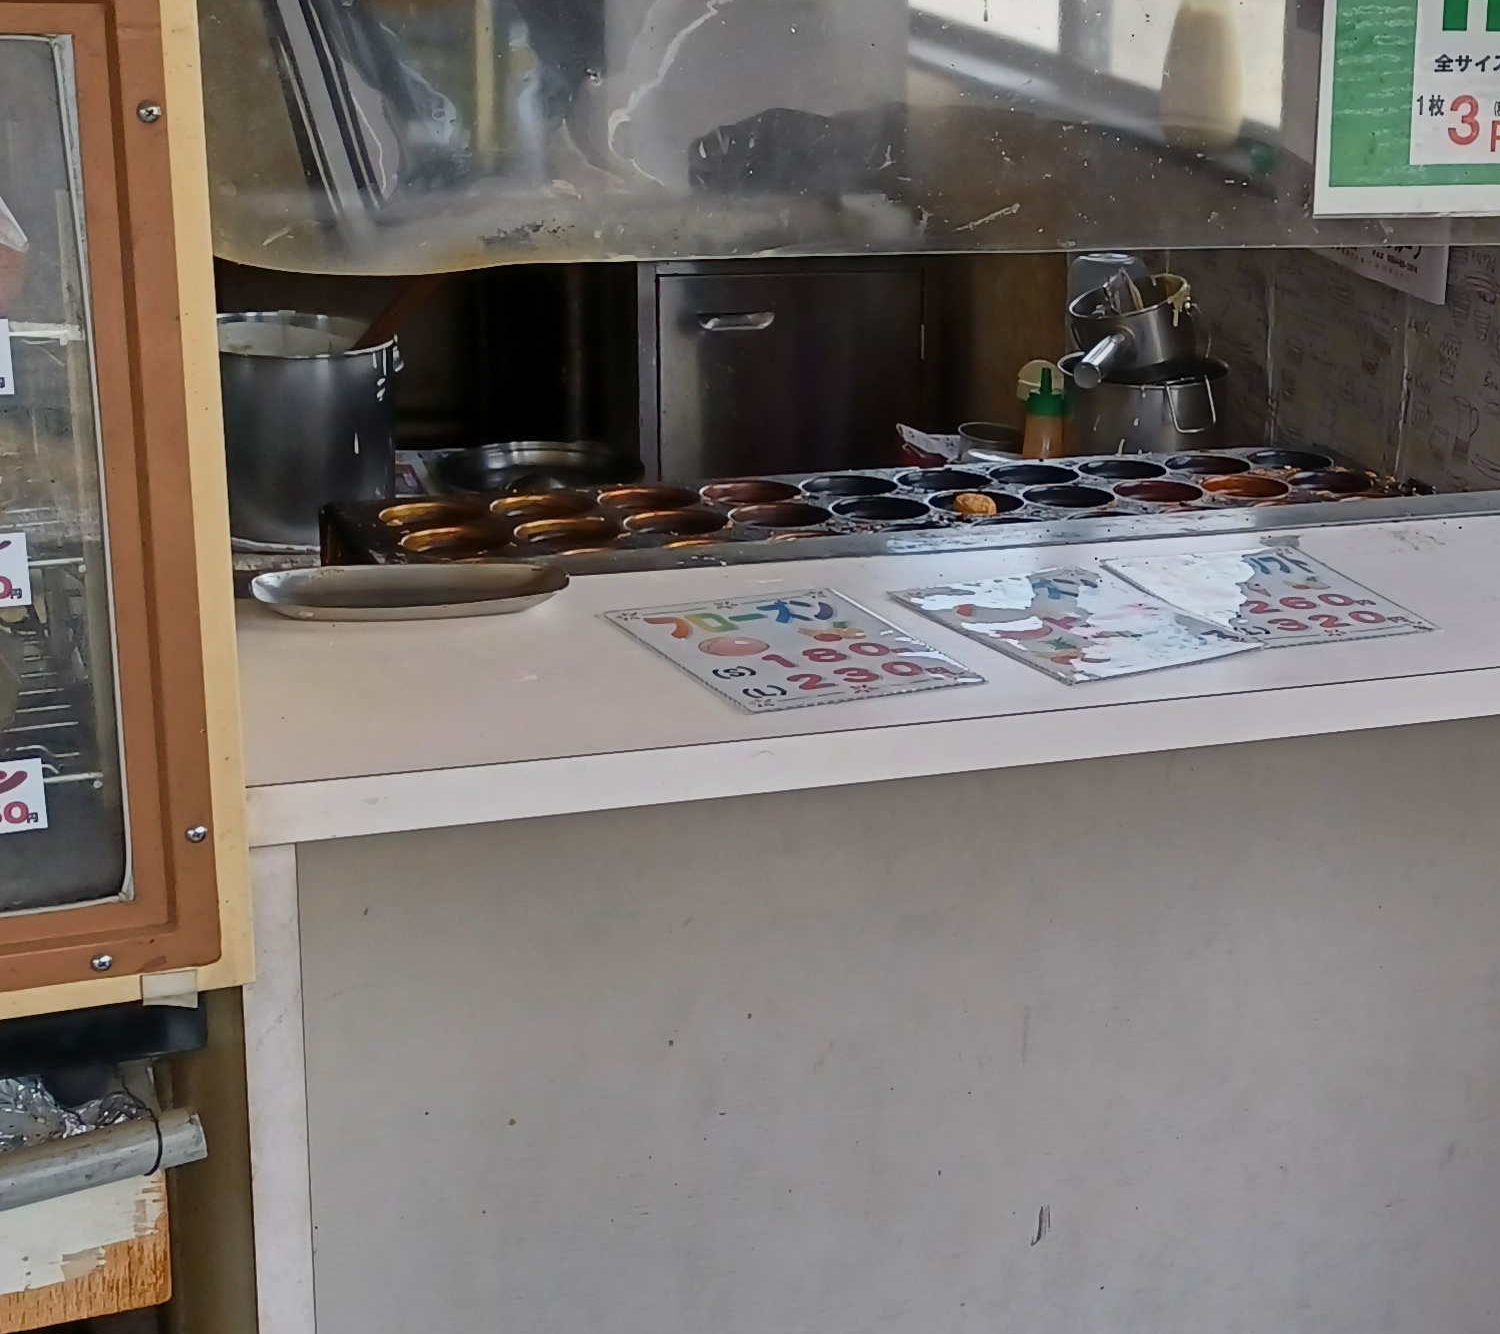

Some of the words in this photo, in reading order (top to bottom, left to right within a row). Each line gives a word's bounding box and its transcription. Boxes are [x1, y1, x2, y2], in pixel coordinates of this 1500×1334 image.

[643, 599, 836, 641] フローズン
[711, 664, 758, 680] (S)
[742, 683, 789, 699] (L)
